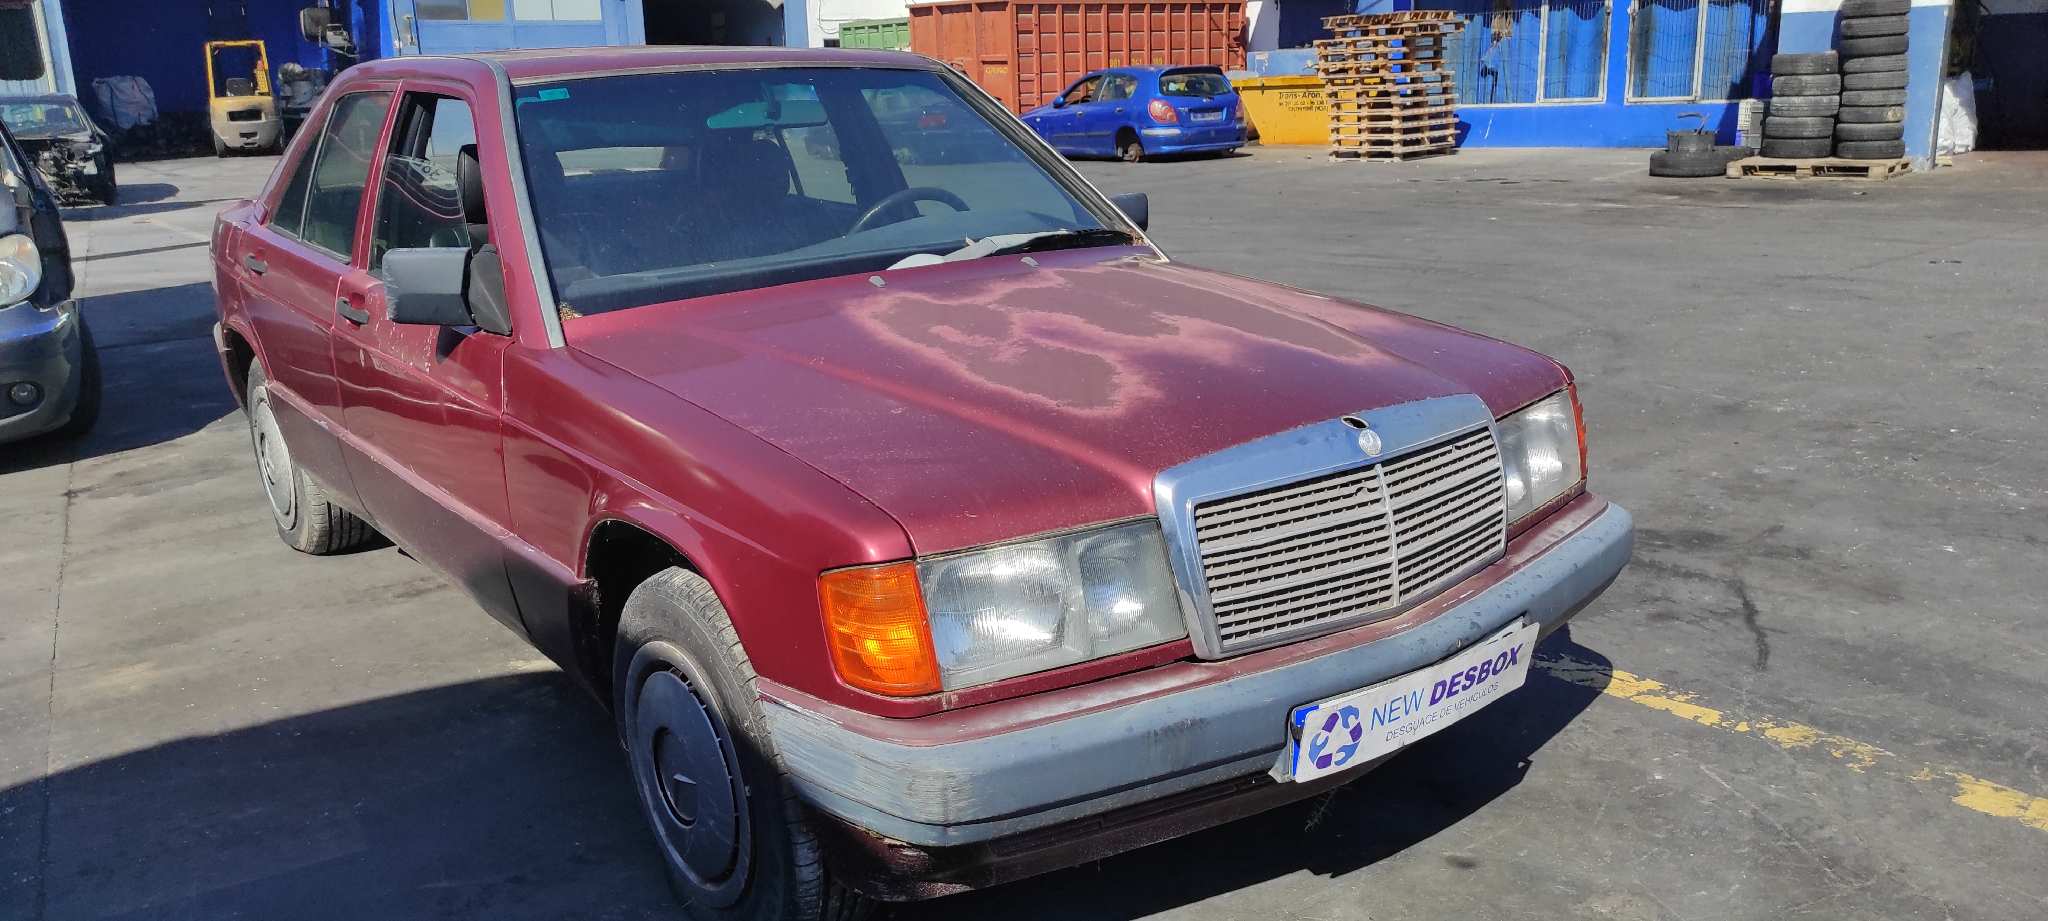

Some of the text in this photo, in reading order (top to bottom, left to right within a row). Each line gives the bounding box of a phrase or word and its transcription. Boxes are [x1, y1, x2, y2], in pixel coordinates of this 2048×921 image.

[1370, 643, 1524, 731] NEW DESBOX
[1386, 711, 1439, 742] DESGUACE
[1439, 703, 1455, 719] DE
